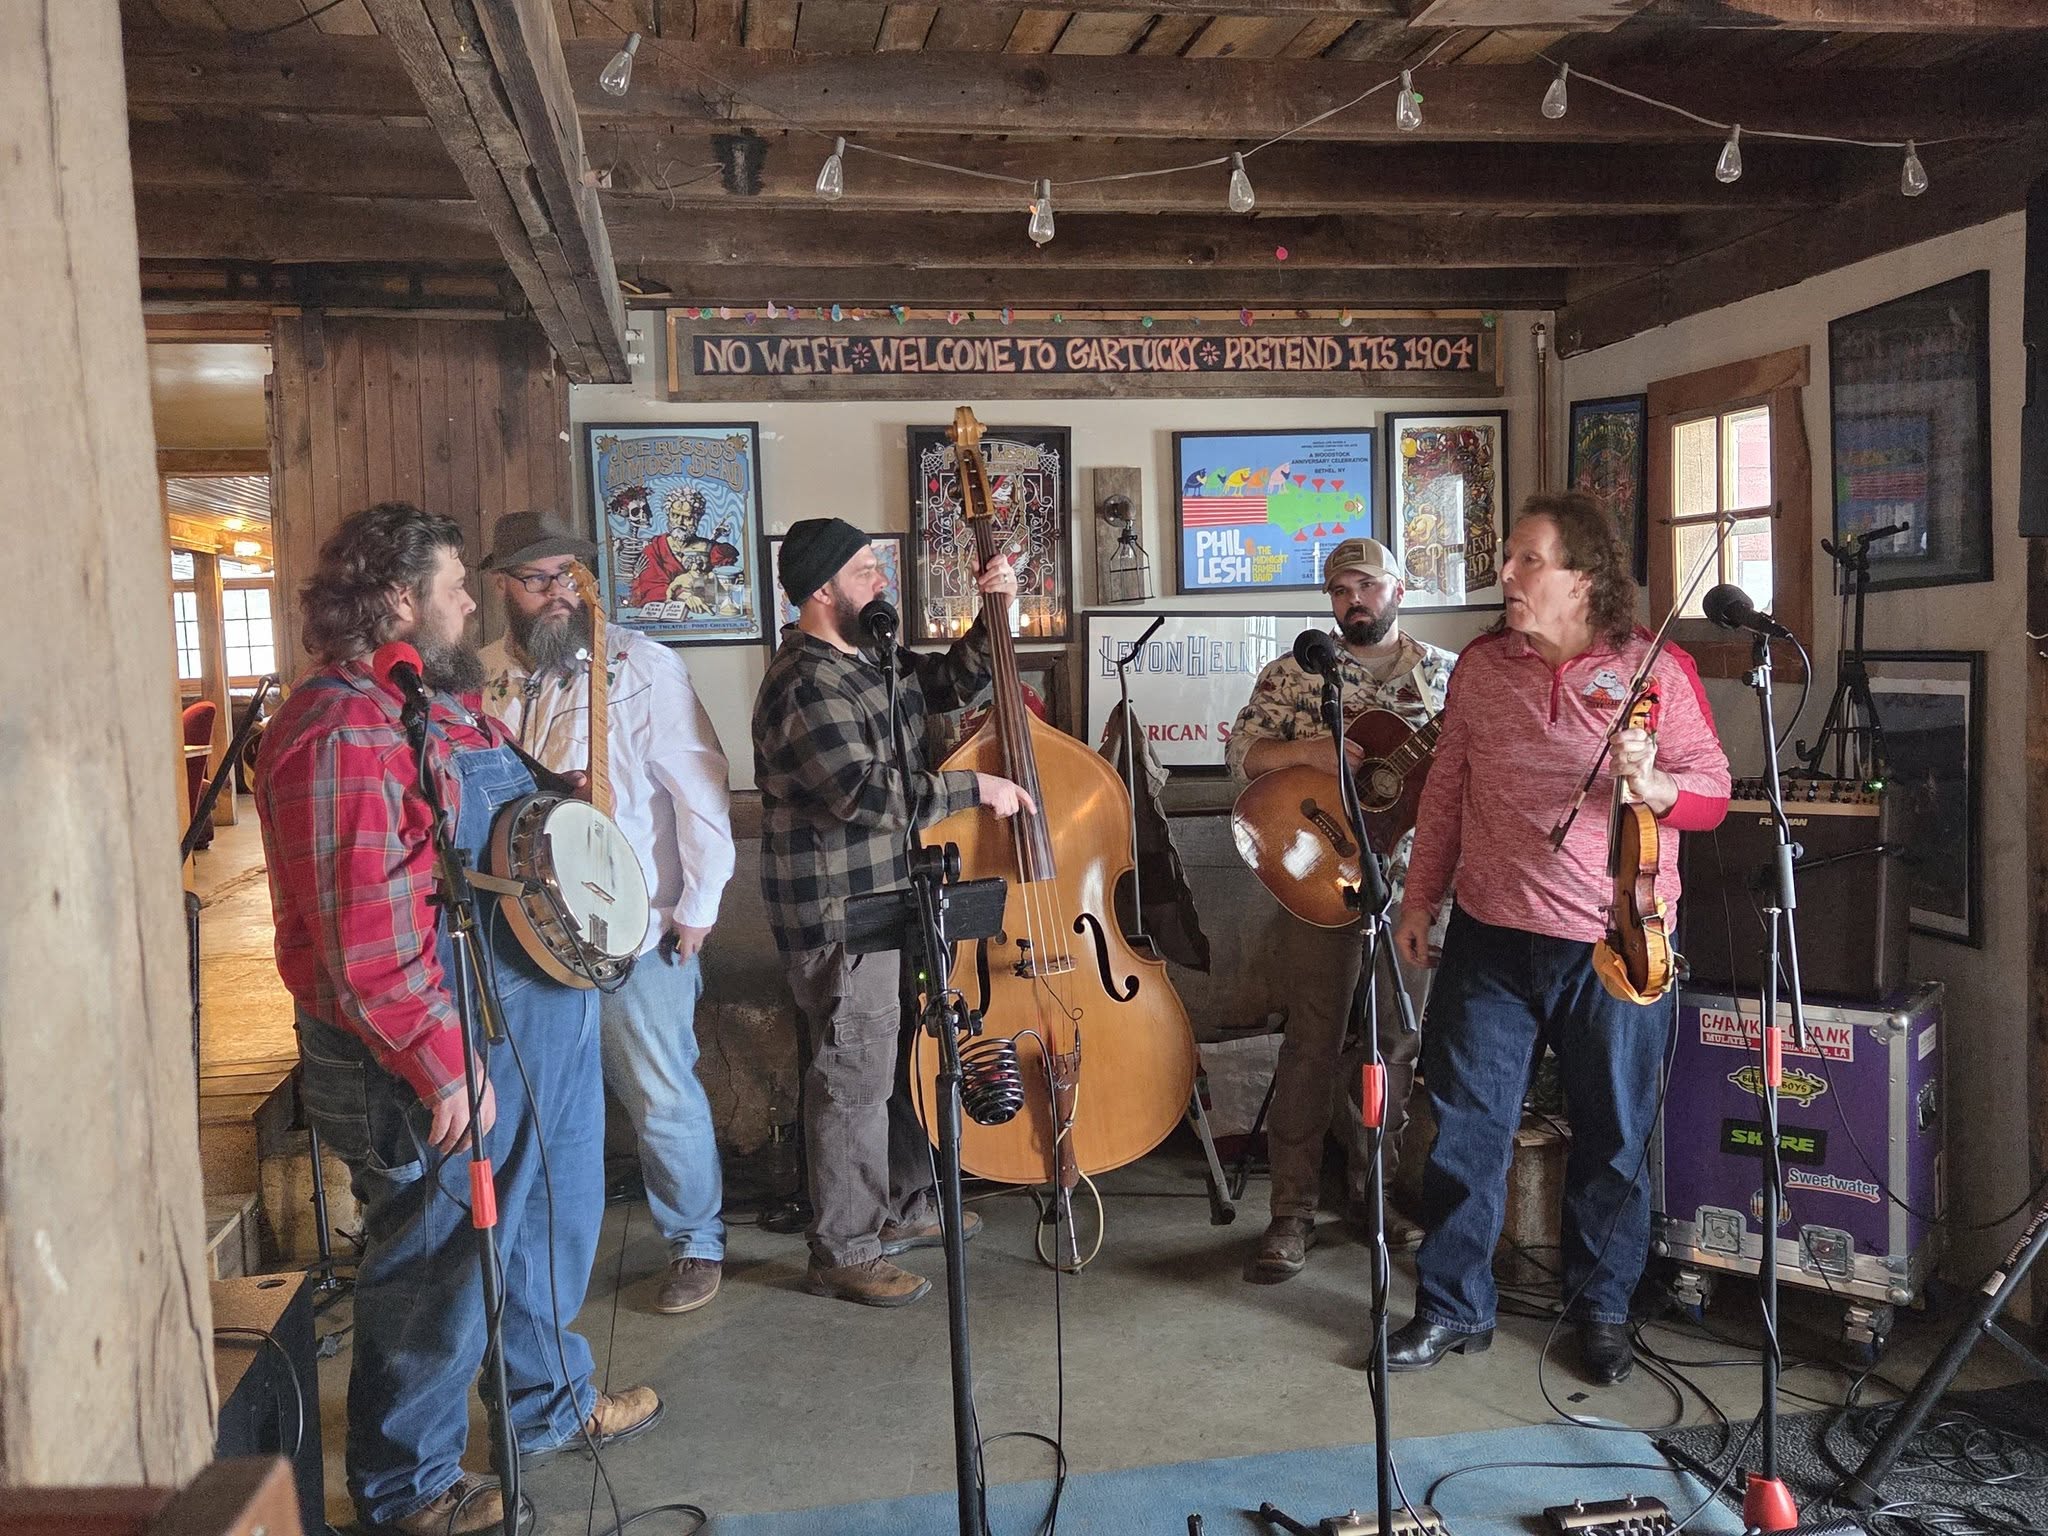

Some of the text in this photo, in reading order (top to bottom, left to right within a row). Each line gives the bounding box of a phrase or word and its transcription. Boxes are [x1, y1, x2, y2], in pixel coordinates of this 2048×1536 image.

[703, 336, 1473, 375] NO WIFI WELCOME TO GARTUCKY PRETEND ITS 1904
[609, 441, 651, 463] JOE
[605, 453, 745, 492] ALMOST DEAD
[1196, 529, 1246, 558] PHIL
[1257, 545, 1272, 555] THE
[1197, 556, 1252, 584] LESH
[1101, 635, 1183, 678] LEVON
[1834, 1048, 1847, 1058] LA
[1781, 1081, 1807, 1093] BOYS
[1730, 1129, 1815, 1153] SHRE
[1788, 1168, 1879, 1196] Sweetwater
